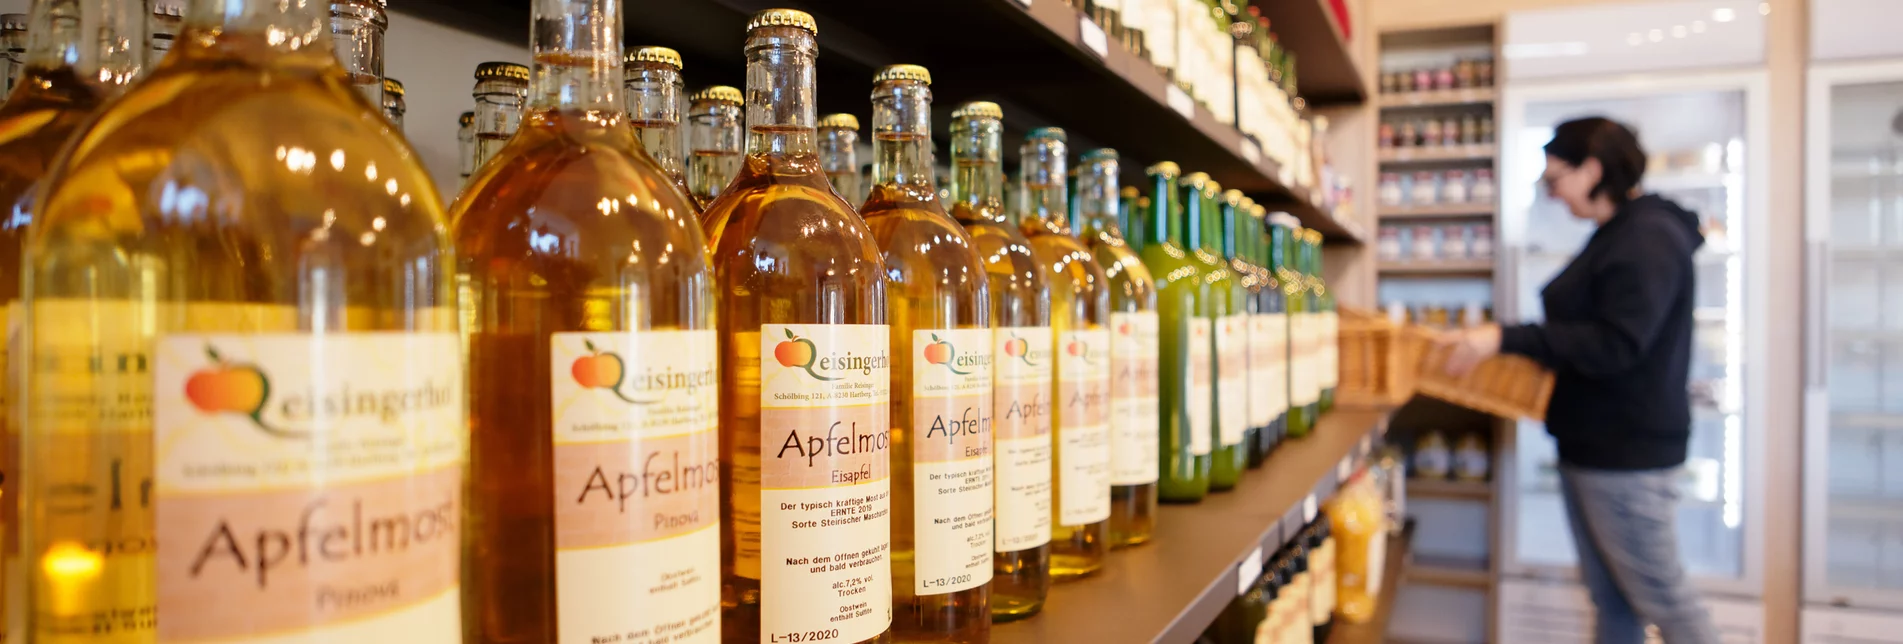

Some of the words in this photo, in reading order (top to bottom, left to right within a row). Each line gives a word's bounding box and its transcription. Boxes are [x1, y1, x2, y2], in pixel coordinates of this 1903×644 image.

[832, 463, 871, 485] Eisapfel
[929, 473, 941, 481] Der
[780, 502, 796, 511] Der
[801, 501, 833, 511] typisch
[831, 507, 856, 517] ERNTE
[859, 504, 872, 513] 2019
[792, 520, 817, 529] Sorte
[821, 515, 861, 527] Steirischer
[786, 557, 809, 566] Nach
[812, 556, 831, 564] dem
[810, 565, 826, 573] und
[830, 562, 846, 572] bald
[923, 574, 972, 588] L-13/2020
[838, 586, 866, 597] Trocken
[840, 602, 867, 613] Obstwein
[771, 628, 839, 643] L-13/2020
